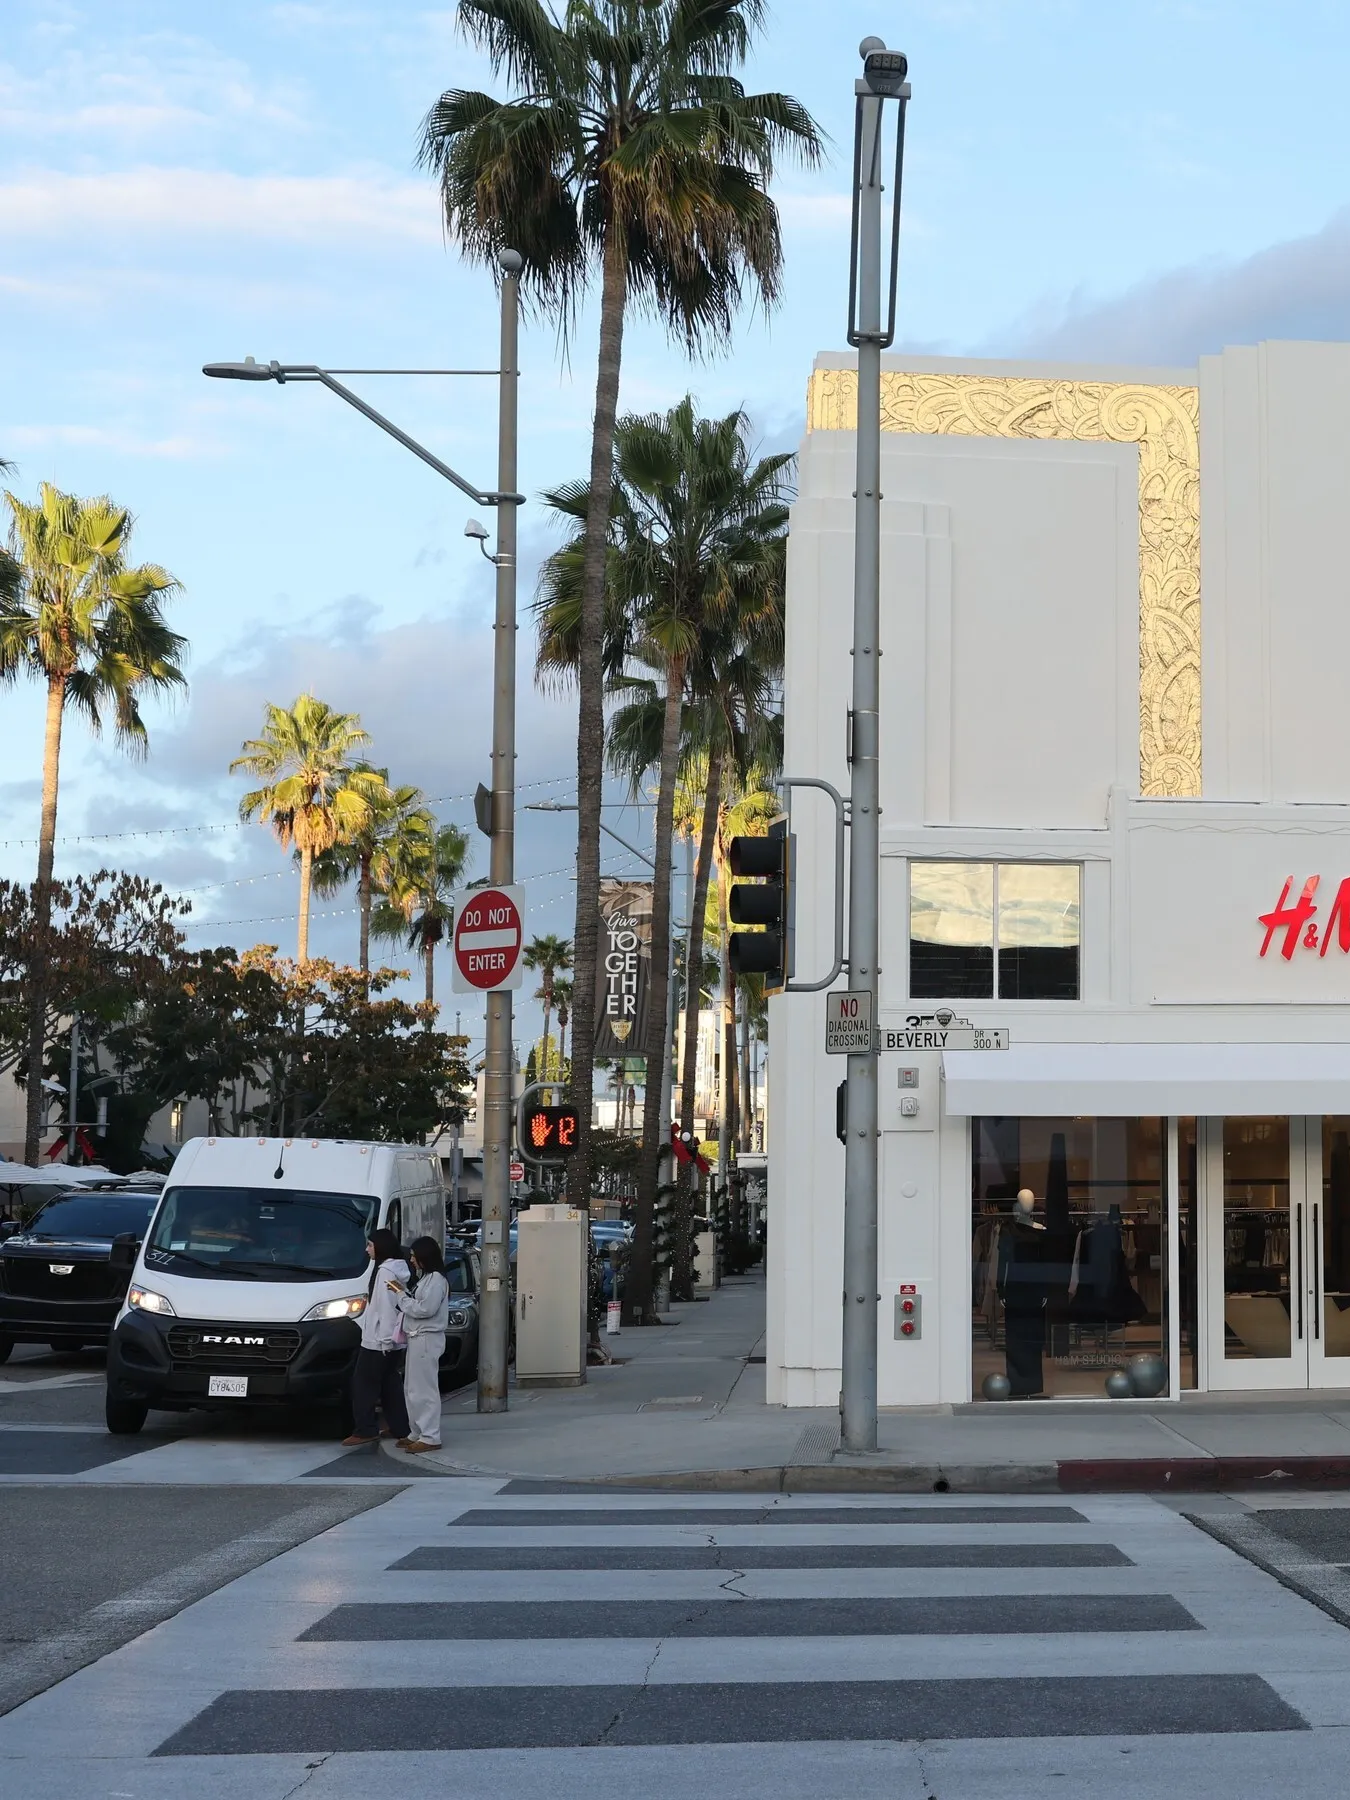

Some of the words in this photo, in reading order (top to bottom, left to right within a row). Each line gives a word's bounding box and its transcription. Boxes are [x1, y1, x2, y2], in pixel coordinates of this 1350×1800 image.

[465, 910, 481, 927] DO
[488, 907, 512, 925] NOT
[608, 912, 639, 931] Give
[468, 953, 506, 972] ENTER
[840, 999, 858, 1018] NO
[828, 1020, 870, 1033] DIAGONAL
[828, 1034, 869, 1047] CROSSING
[887, 1032, 949, 1048] BEVERLY
[974, 1030, 985, 1038] DR
[973, 1039, 991, 1049] 300
[996, 1039, 1001, 1048] N
[566, 1211, 579, 1220] 34
[145, 1250, 176, 1266] 311
[202, 1335, 265, 1345] RAM
